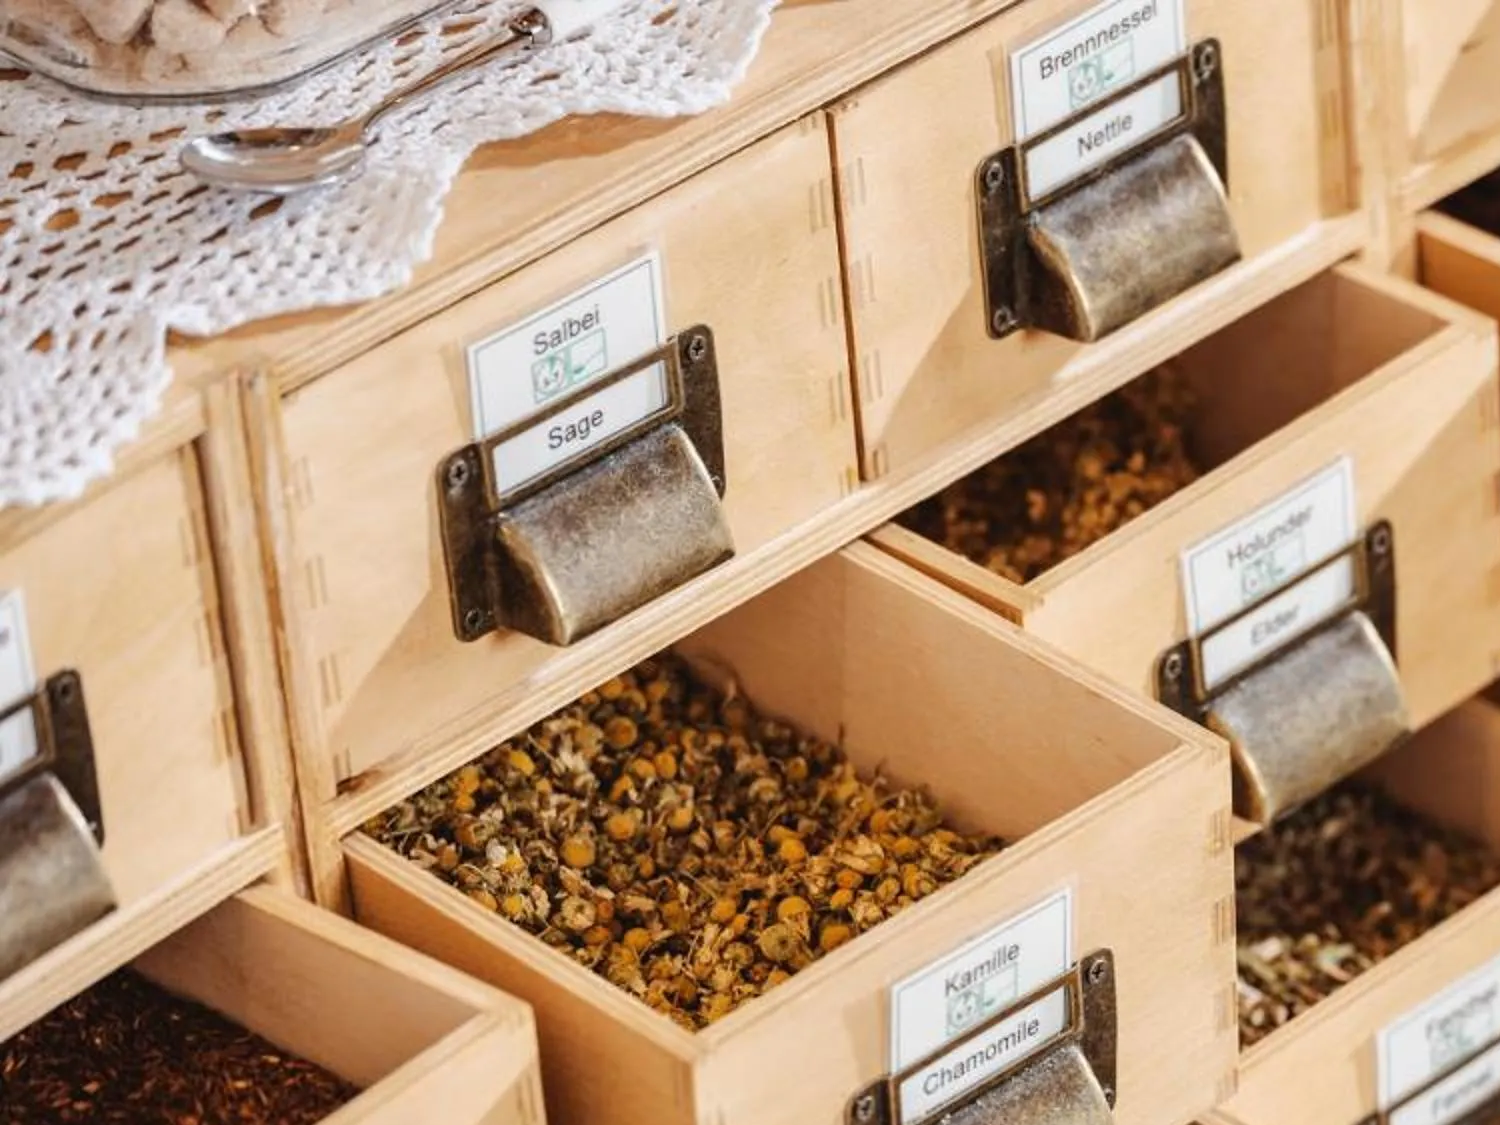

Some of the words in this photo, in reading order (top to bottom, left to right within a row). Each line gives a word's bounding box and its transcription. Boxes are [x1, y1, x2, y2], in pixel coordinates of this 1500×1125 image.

[1039, 1, 1157, 80] Brennnessel
[1077, 114, 1133, 157] Nettle
[533, 303, 600, 355] Salbei
[547, 409, 604, 450] Sage
[1227, 504, 1313, 568] Holunder
[1251, 604, 1299, 647] Elder
[944, 943, 1020, 998] Kamille
[922, 1016, 1040, 1096] Chamomile
